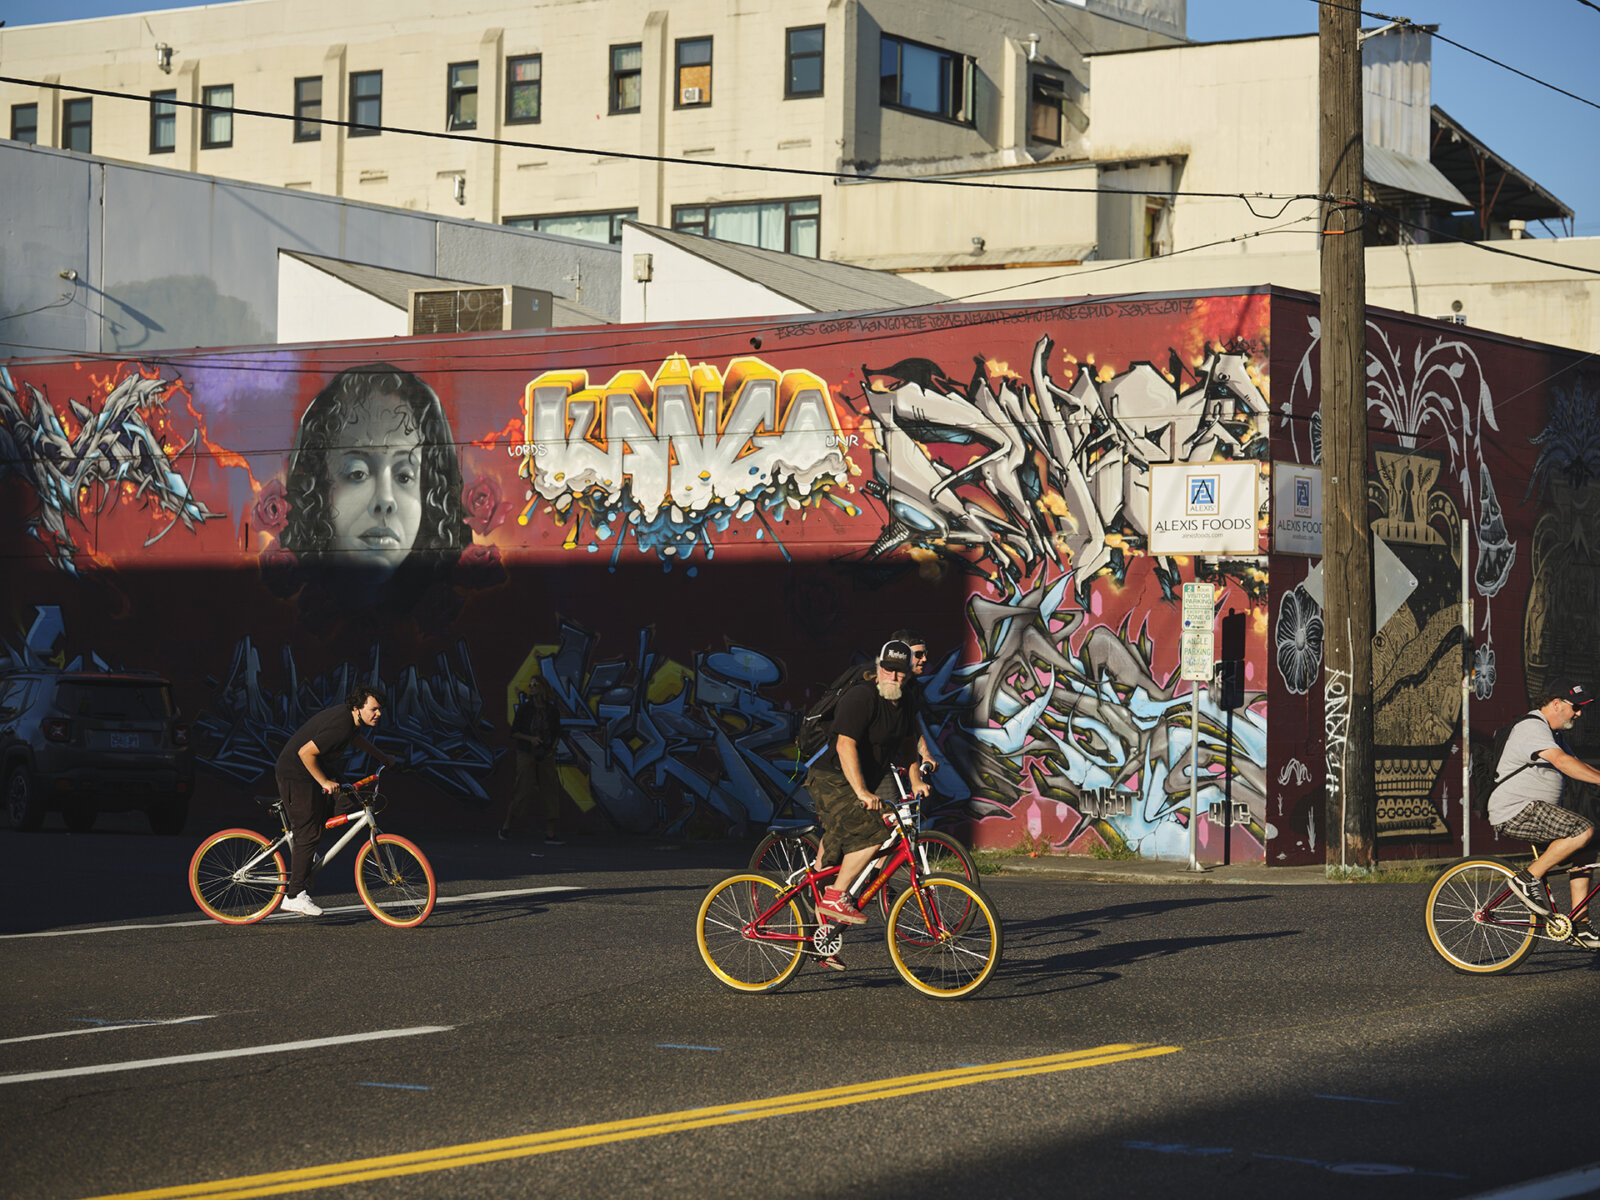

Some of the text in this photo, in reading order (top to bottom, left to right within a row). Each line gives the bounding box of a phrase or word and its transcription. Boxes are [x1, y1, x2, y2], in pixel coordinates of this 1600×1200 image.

[826, 434, 859, 448] UNR
[507, 444, 548, 457] LORDS
[1155, 518, 1251, 532] ALEXIS FOODS
[1278, 520, 1301, 532] ALEXIS
[1187, 637, 1208, 645] ANGLE
[1184, 647, 1210, 655] PARKING
